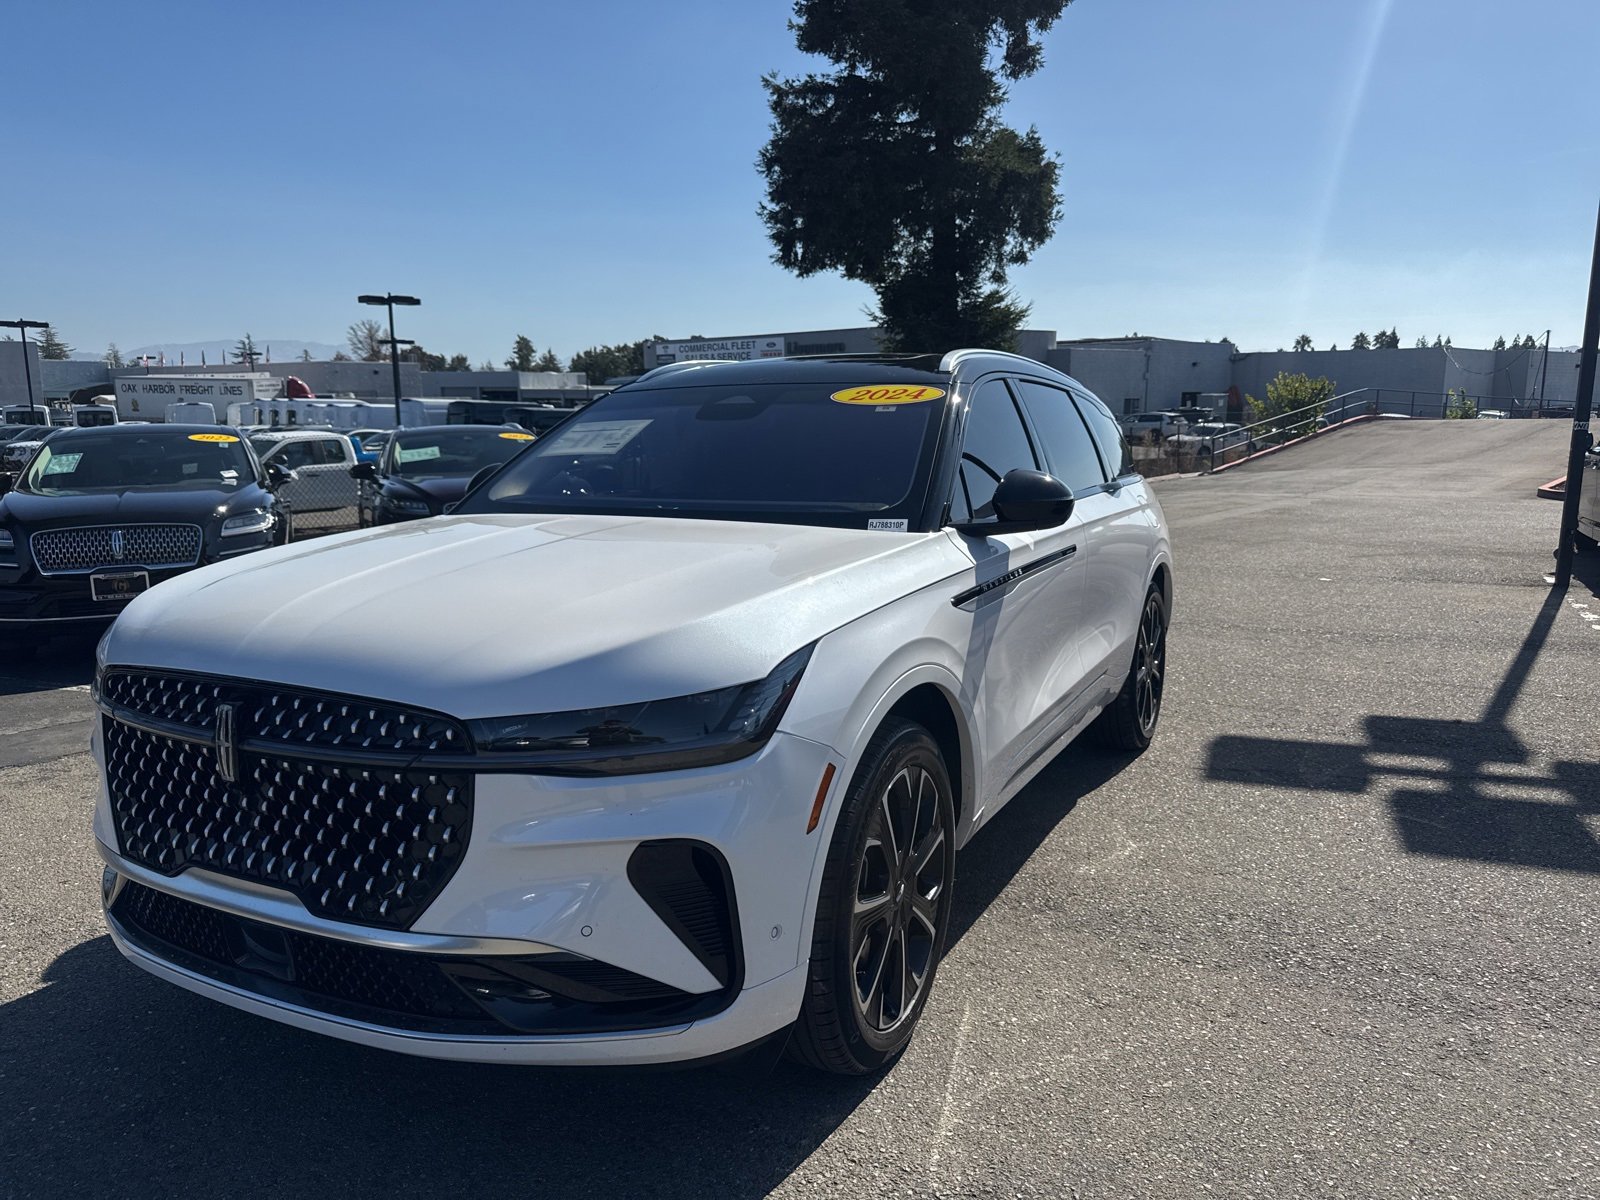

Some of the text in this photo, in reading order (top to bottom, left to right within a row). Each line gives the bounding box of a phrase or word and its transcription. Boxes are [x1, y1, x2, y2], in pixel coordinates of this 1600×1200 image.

[678, 342, 731, 353] COMMERCIAL
[731, 341, 757, 350] FLEET
[717, 352, 751, 361] SERVICE
[121, 384, 243, 396] OAK HARBOR FREIGHT LINES
[848, 388, 928, 401] 2024
[869, 521, 904, 529] RJ788310P
[982, 568, 1023, 592] NAUTILUS
